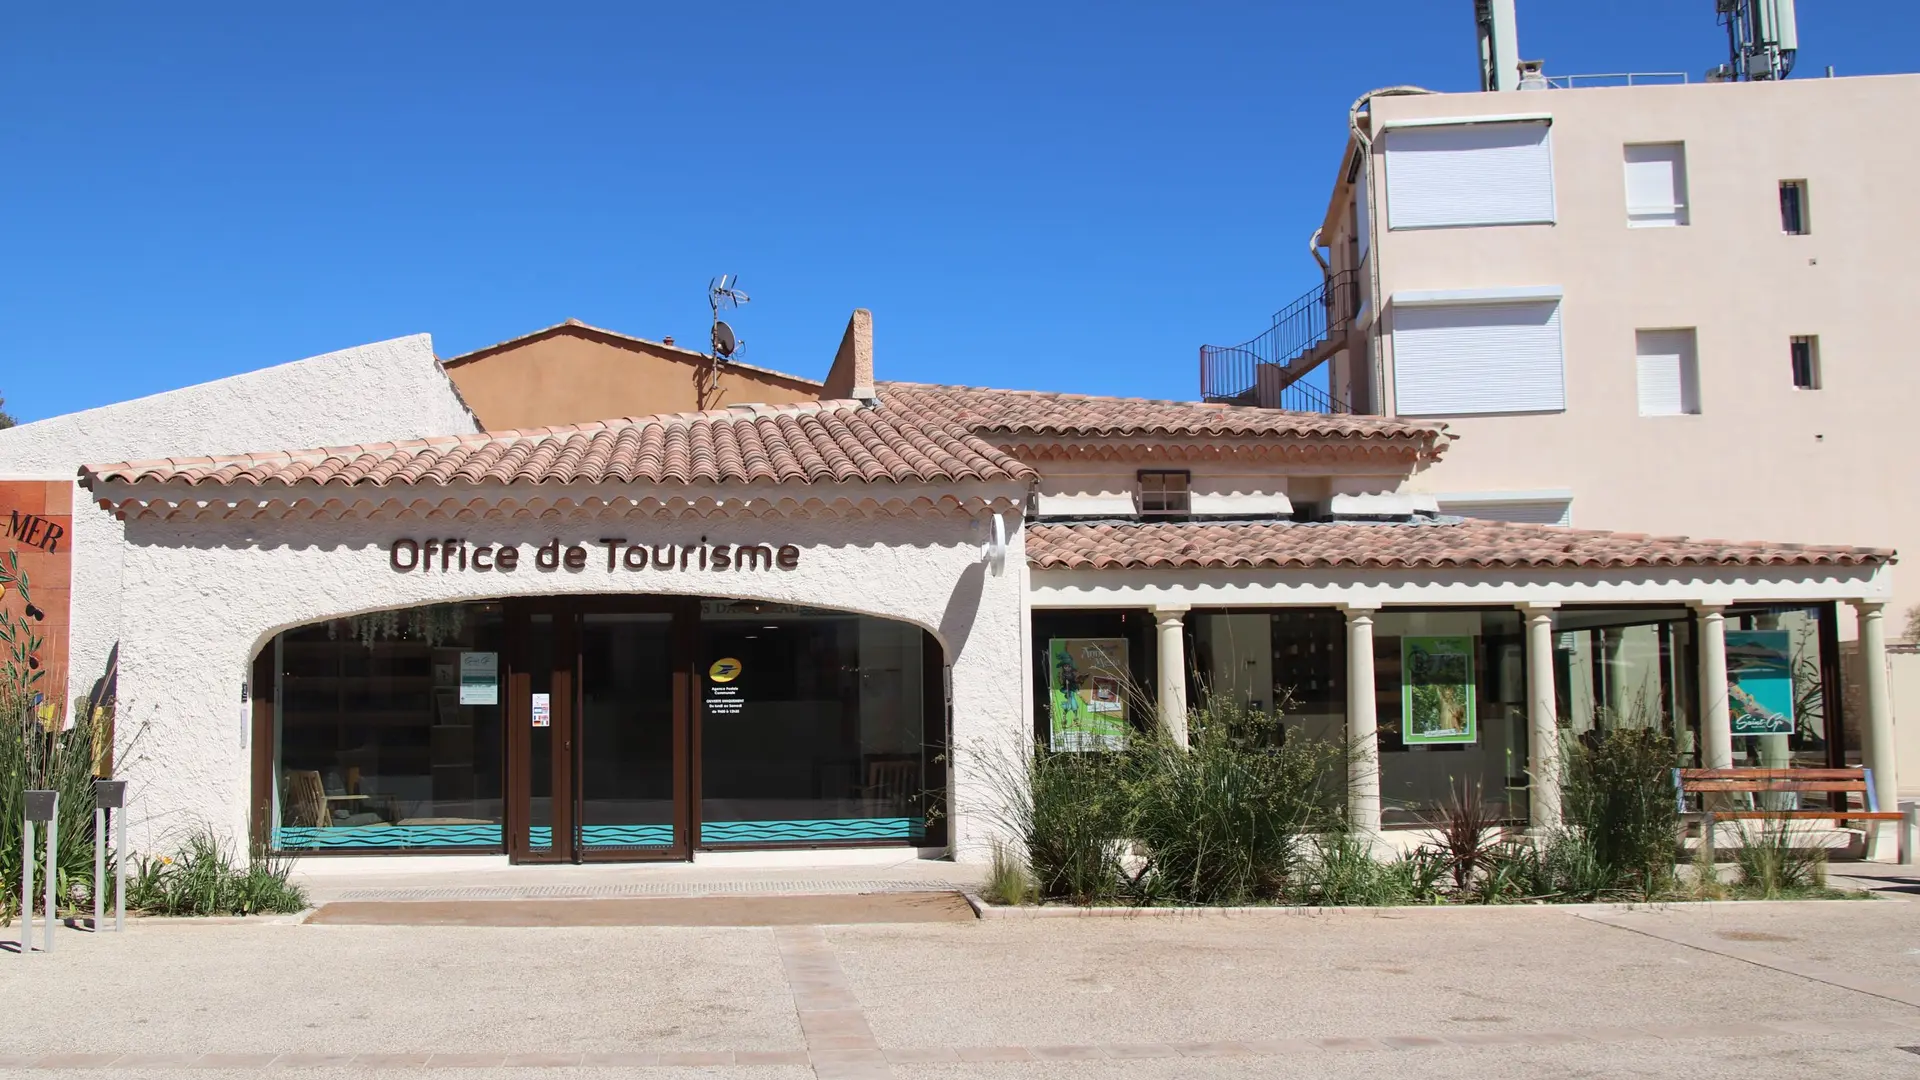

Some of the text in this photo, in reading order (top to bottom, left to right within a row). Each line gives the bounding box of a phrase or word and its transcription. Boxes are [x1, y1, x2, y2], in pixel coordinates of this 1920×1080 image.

[390, 536, 800, 573] Office de Tourisme
